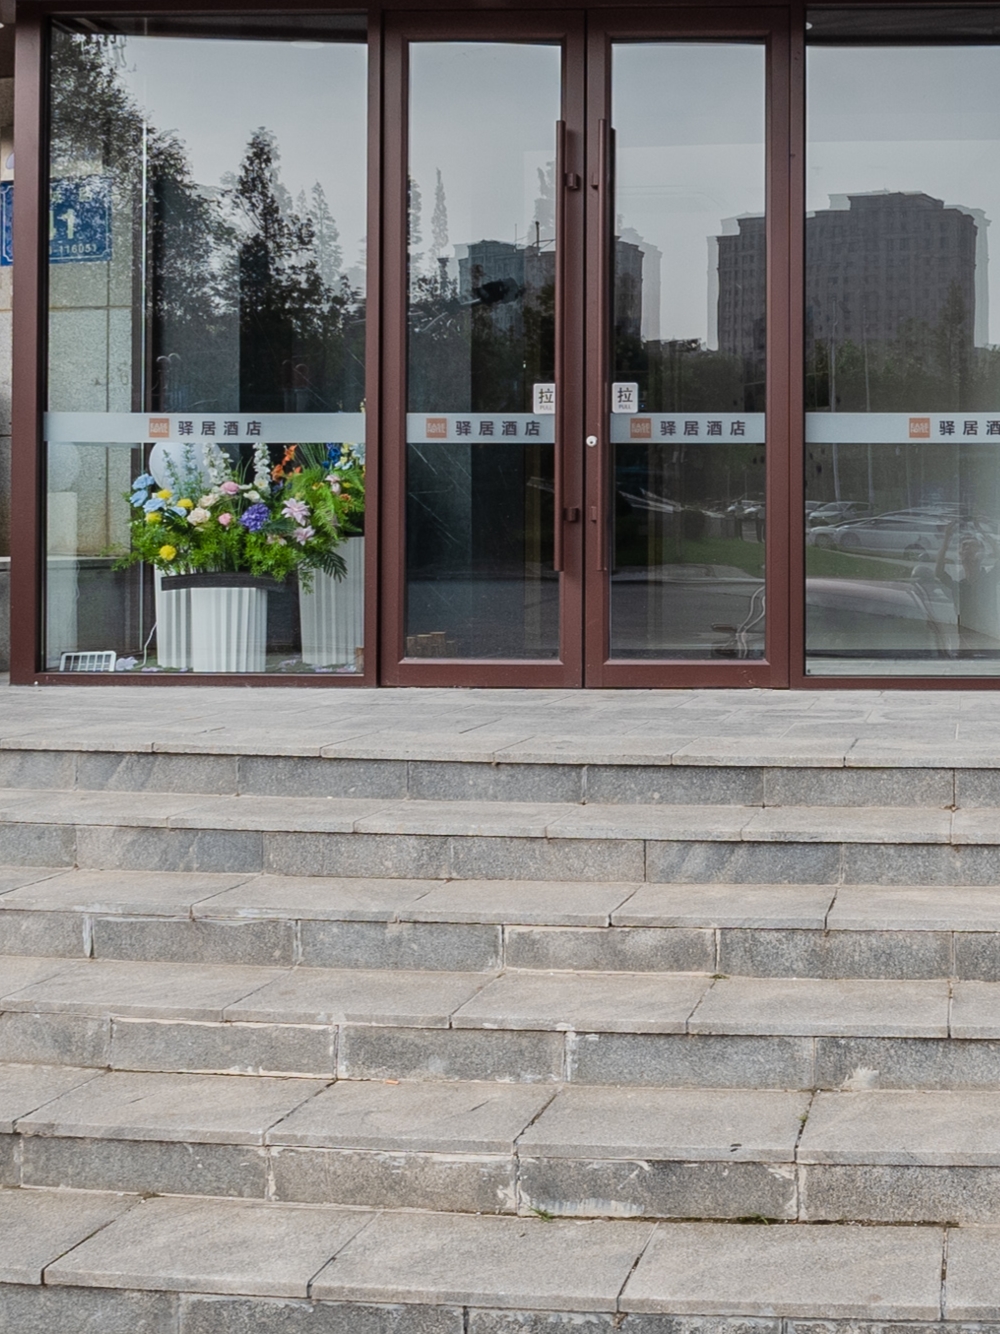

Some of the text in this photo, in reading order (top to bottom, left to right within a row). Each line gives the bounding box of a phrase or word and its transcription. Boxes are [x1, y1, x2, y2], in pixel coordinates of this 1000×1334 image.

[538, 387, 554, 404] 拉
[617, 387, 633, 403] 拉
[178, 420, 261, 436] 驿居酒店
[455, 420, 541, 436] 驿居酒店
[660, 420, 746, 436] 驿居酒店
